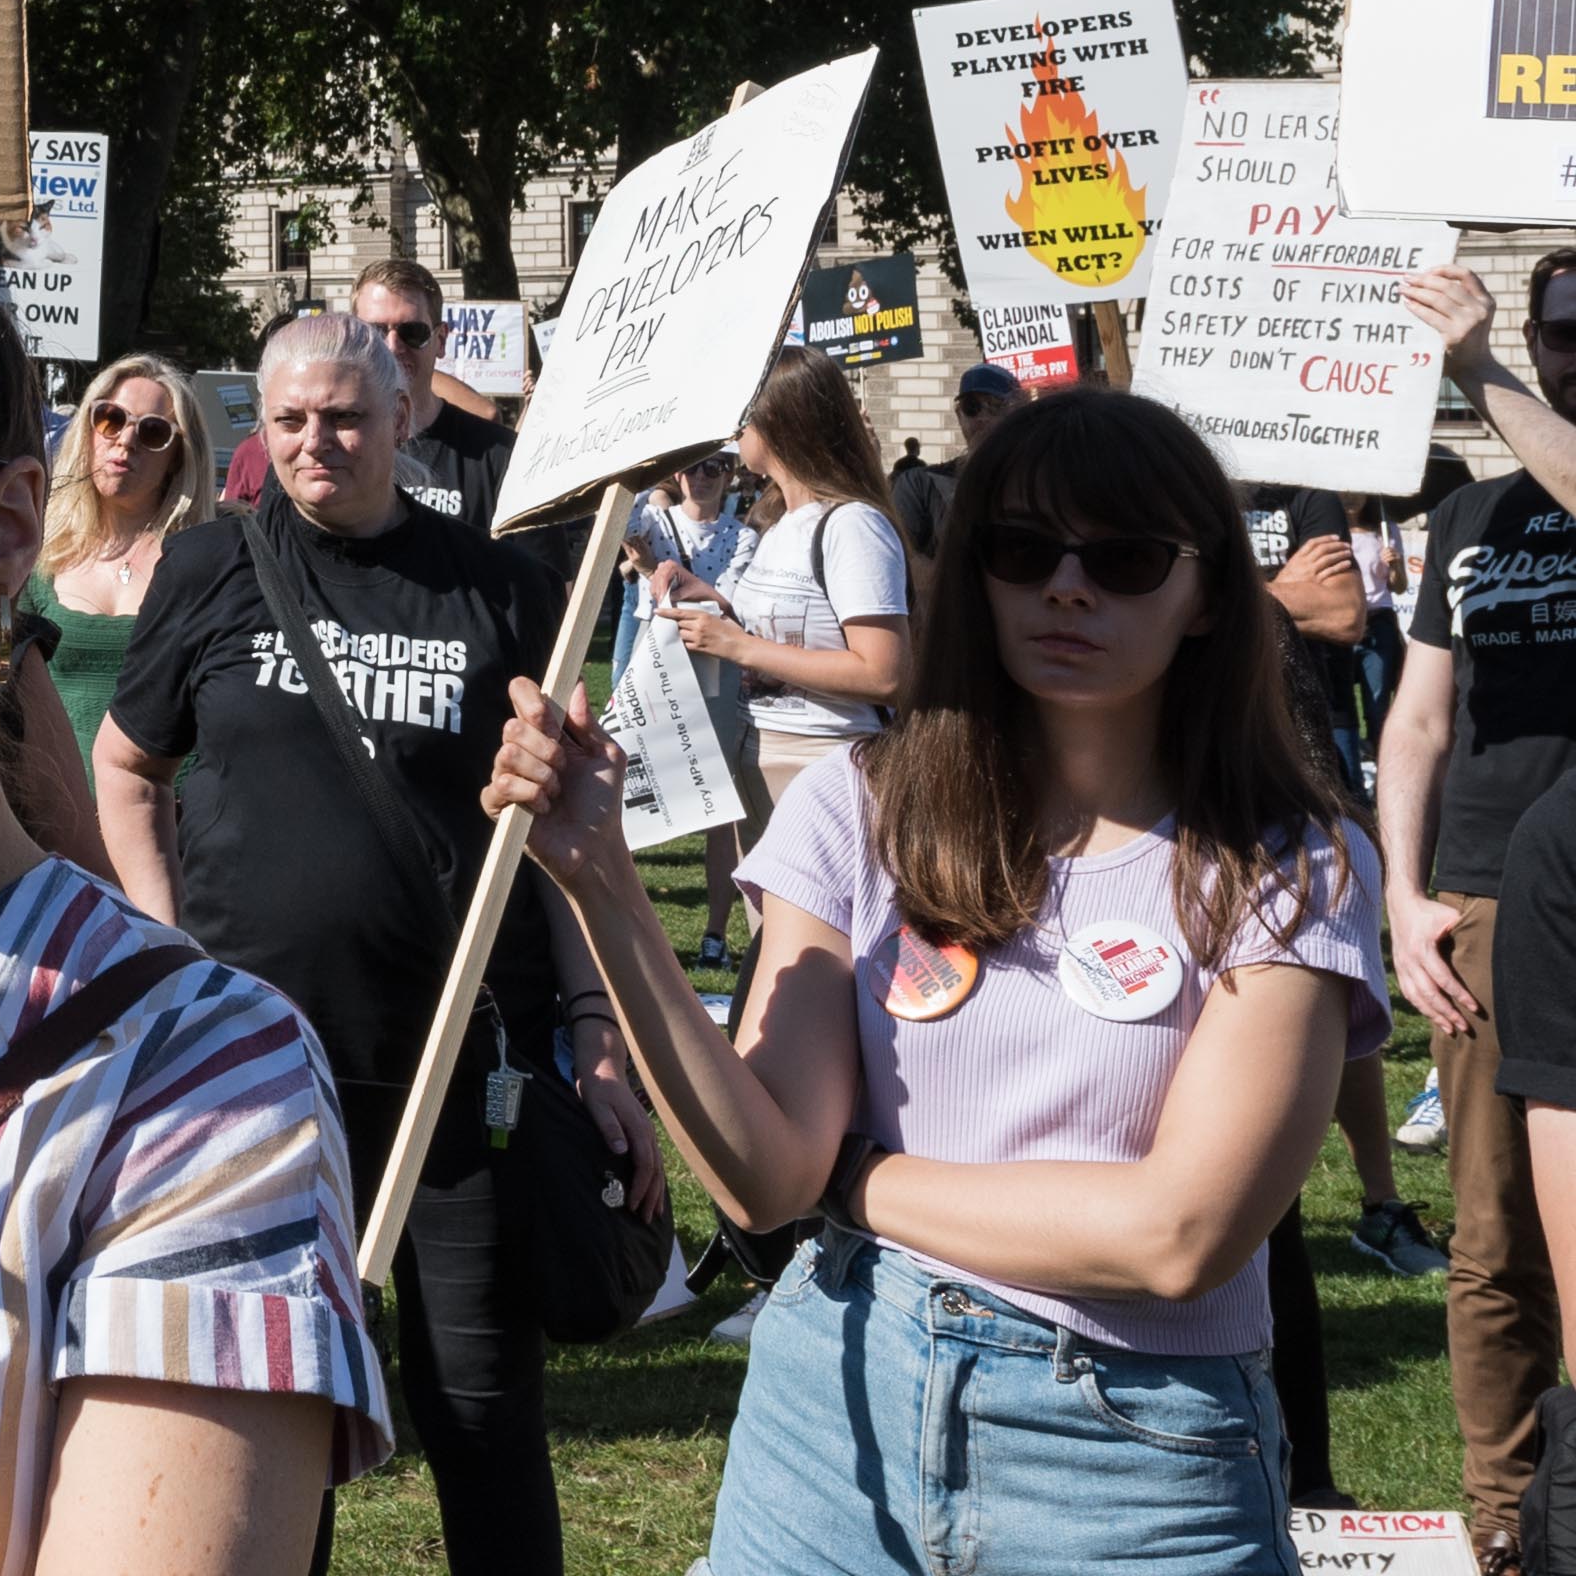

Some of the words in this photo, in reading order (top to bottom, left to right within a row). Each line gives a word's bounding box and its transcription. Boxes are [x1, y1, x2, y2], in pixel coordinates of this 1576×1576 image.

[955, 10, 1134, 49] DEVELOPERS
[952, 46, 1067, 78] PLAYING
[1073, 37, 1149, 65] WITH
[1021, 75, 1085, 98] FIRE
[1202, 110, 1246, 140] NO
[46, 140, 100, 163] SAYS
[975, 137, 1076, 163] PROFIT
[1083, 129, 1159, 150] OVER
[1033, 163, 1109, 186] LIVES
[1197, 156, 1295, 185] SHOULD
[69, 200, 98, 214] Ltd.
[625, 148, 742, 262] MAKE
[1249, 203, 1336, 236] PAY
[976, 226, 1060, 251] WHEN
[1063, 222, 1134, 246] WILL
[1056, 249, 1123, 274] ACT?
[1171, 237, 1213, 260] FOR
[1225, 239, 1261, 262] THE
[1272, 241, 1422, 270] UNAFFORDABLE
[44, 273, 72, 292] UP
[576, 198, 779, 341] DEVELOPERS
[1169, 276, 1243, 301] COSTS
[1273, 279, 1300, 302] OF
[1321, 281, 1401, 305] FIXING
[26, 304, 79, 325] OWN
[448, 308, 495, 333] WAY
[809, 316, 853, 343] ABOLISH
[854, 314, 874, 335] NOT
[876, 306, 913, 330] POLISH
[983, 304, 1062, 330] CLADDING
[1161, 311, 1246, 338] SAFETY
[1258, 317, 1344, 341] DEFECTS
[1352, 325, 1413, 346] THAT
[599, 312, 665, 380] PAY
[987, 322, 1059, 353] SCANDAL
[1049, 361, 1068, 376] PAY
[1159, 345, 1213, 368] THEY
[1229, 348, 1296, 371] DIDN'T
[1299, 355, 1395, 395] CAUSE
[1471, 633, 1521, 648] TRADE
[625, 666, 647, 728] cladding
[659, 671, 674, 696] The
[671, 699, 683, 721] For
[677, 723, 693, 753] Vote
[700, 788, 717, 816] Tory
[1340, 1514, 1446, 1534] ACTION
[1300, 1551, 1397, 1574] EMPTY
